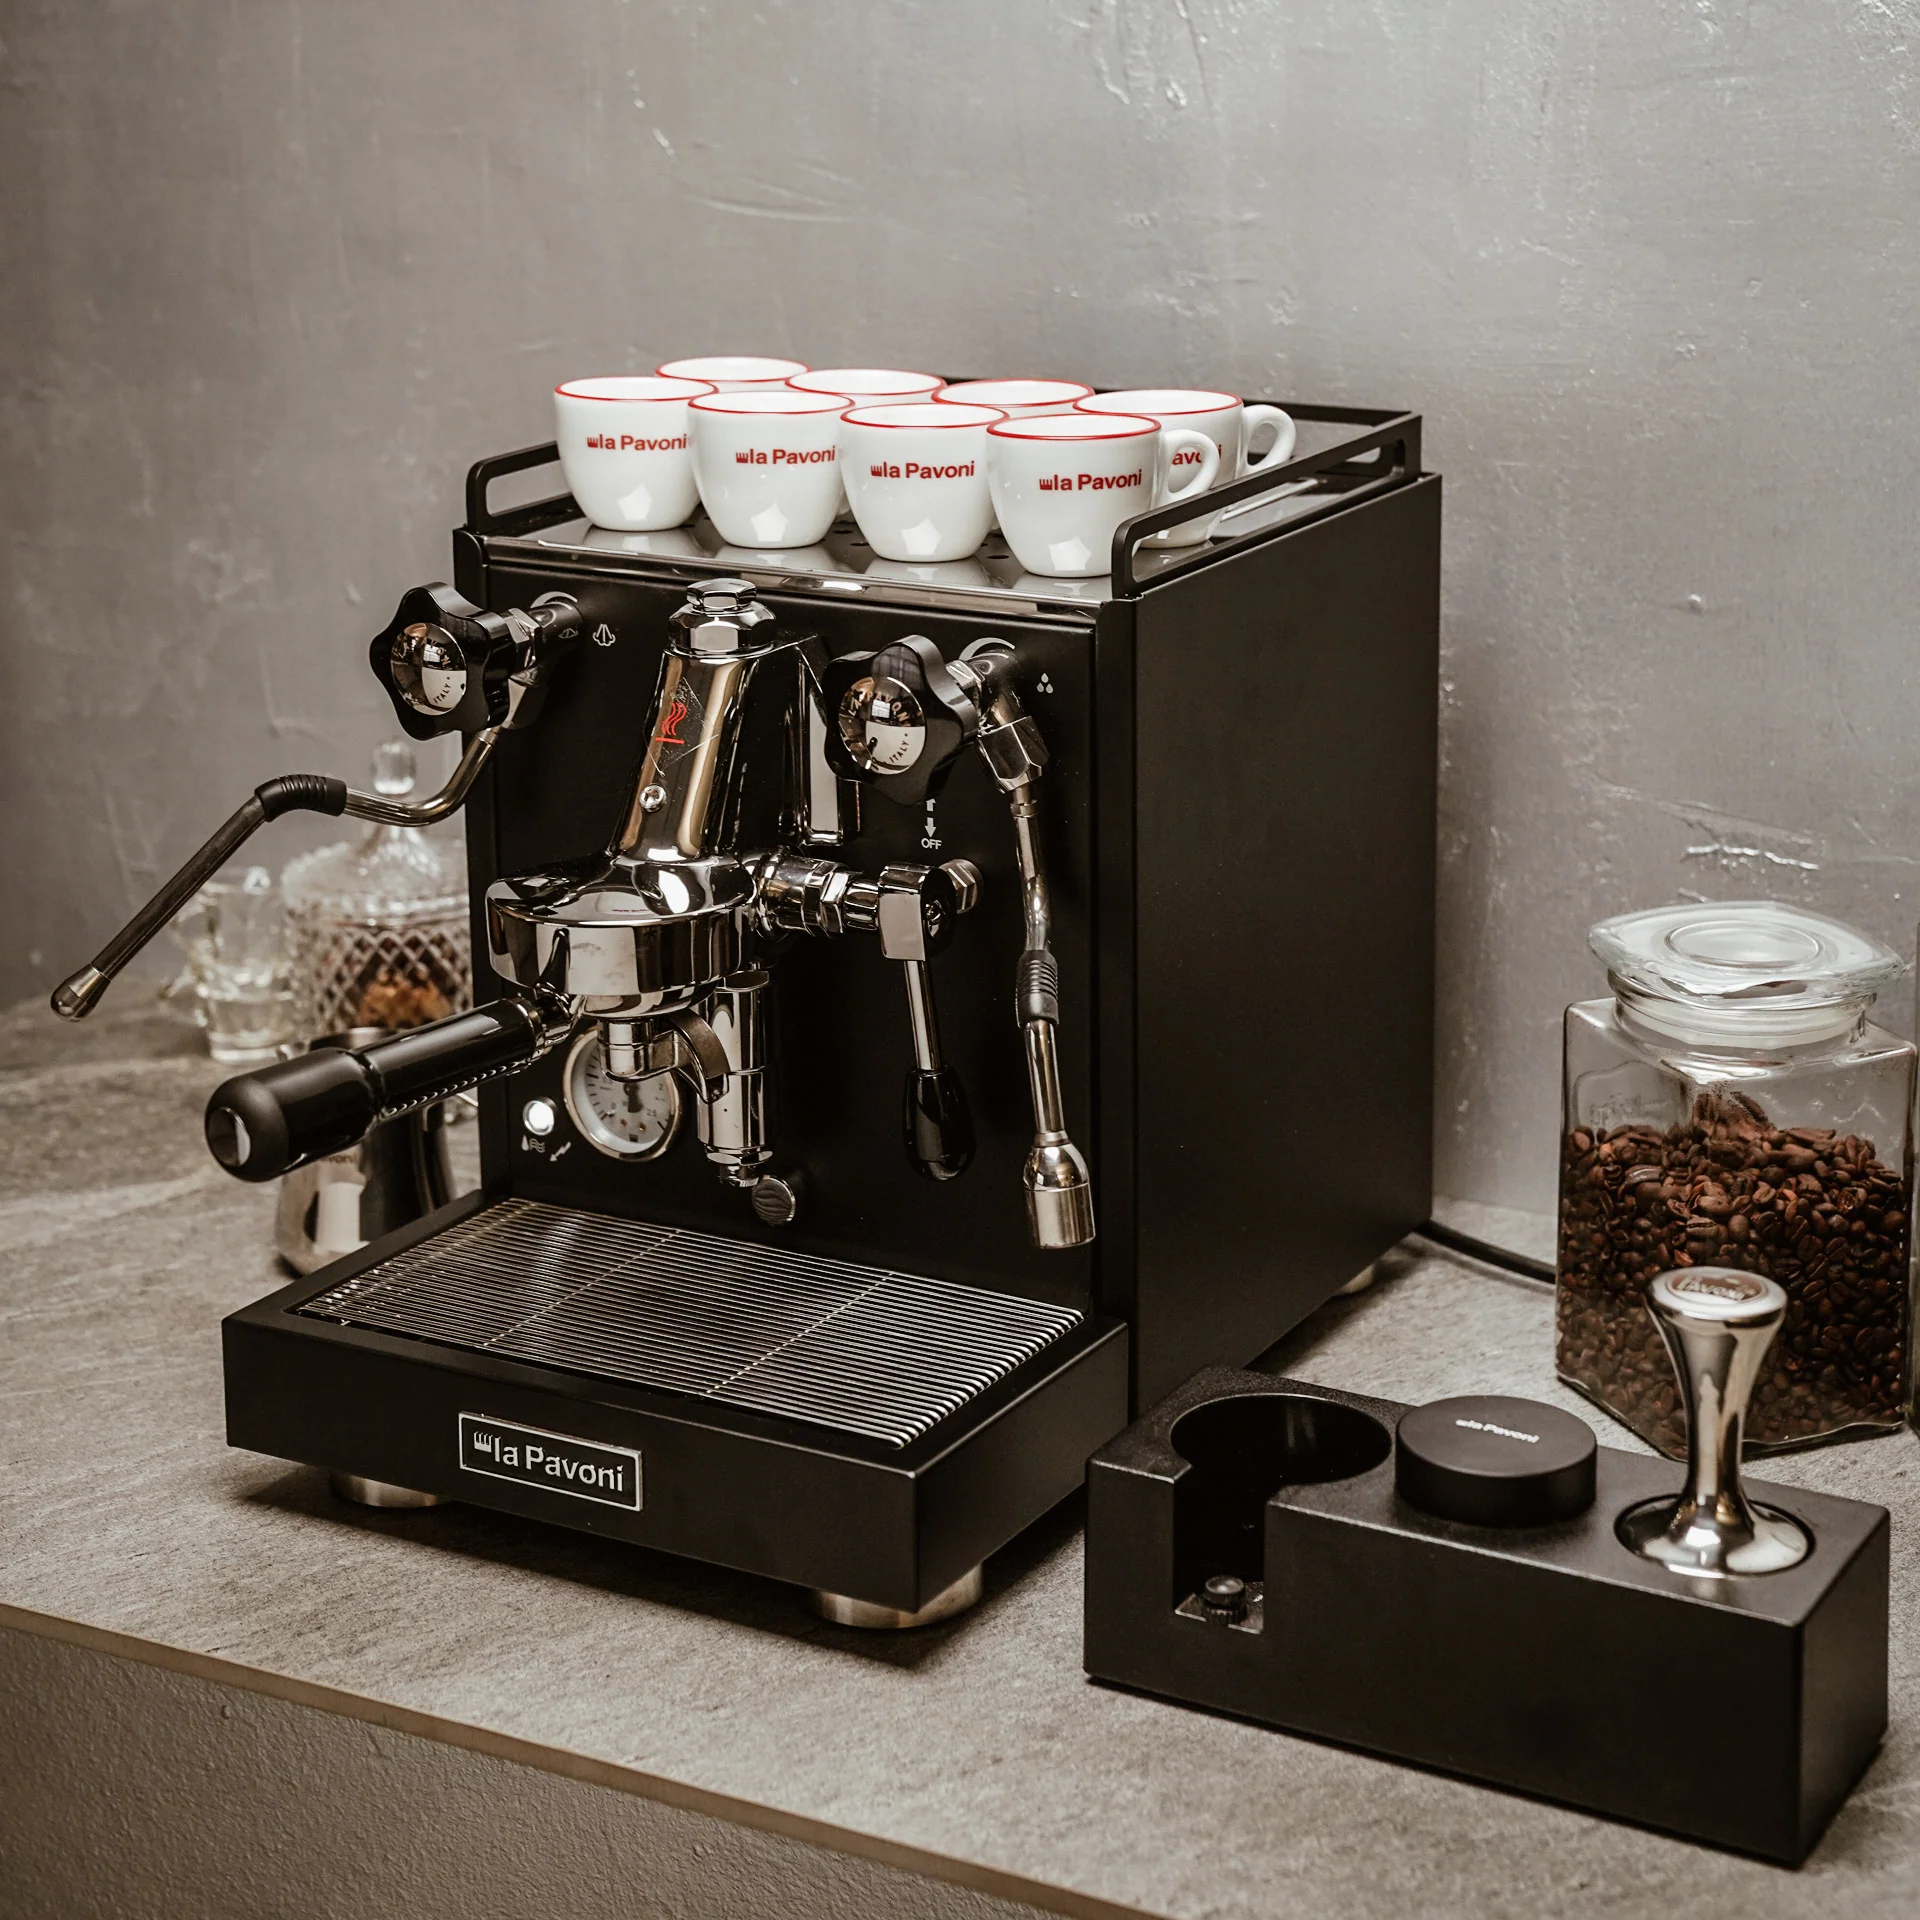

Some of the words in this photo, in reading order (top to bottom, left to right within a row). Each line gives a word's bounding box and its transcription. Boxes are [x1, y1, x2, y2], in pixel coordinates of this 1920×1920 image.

[599, 434, 616, 450] la
[620, 433, 687, 451] Pavoni
[749, 448, 768, 465] la
[772, 445, 836, 465] Pavoni
[883, 461, 900, 479] la
[905, 460, 975, 479] Pavoni
[1053, 474, 1073, 491] la
[1077, 468, 1142, 491] Pavoni
[432, 683, 452, 704] ITALY
[888, 740, 910, 764] ITALY
[920, 837, 943, 850] OFF
[494, 1435, 520, 1467] la
[525, 1444, 624, 1492] Pavoni
